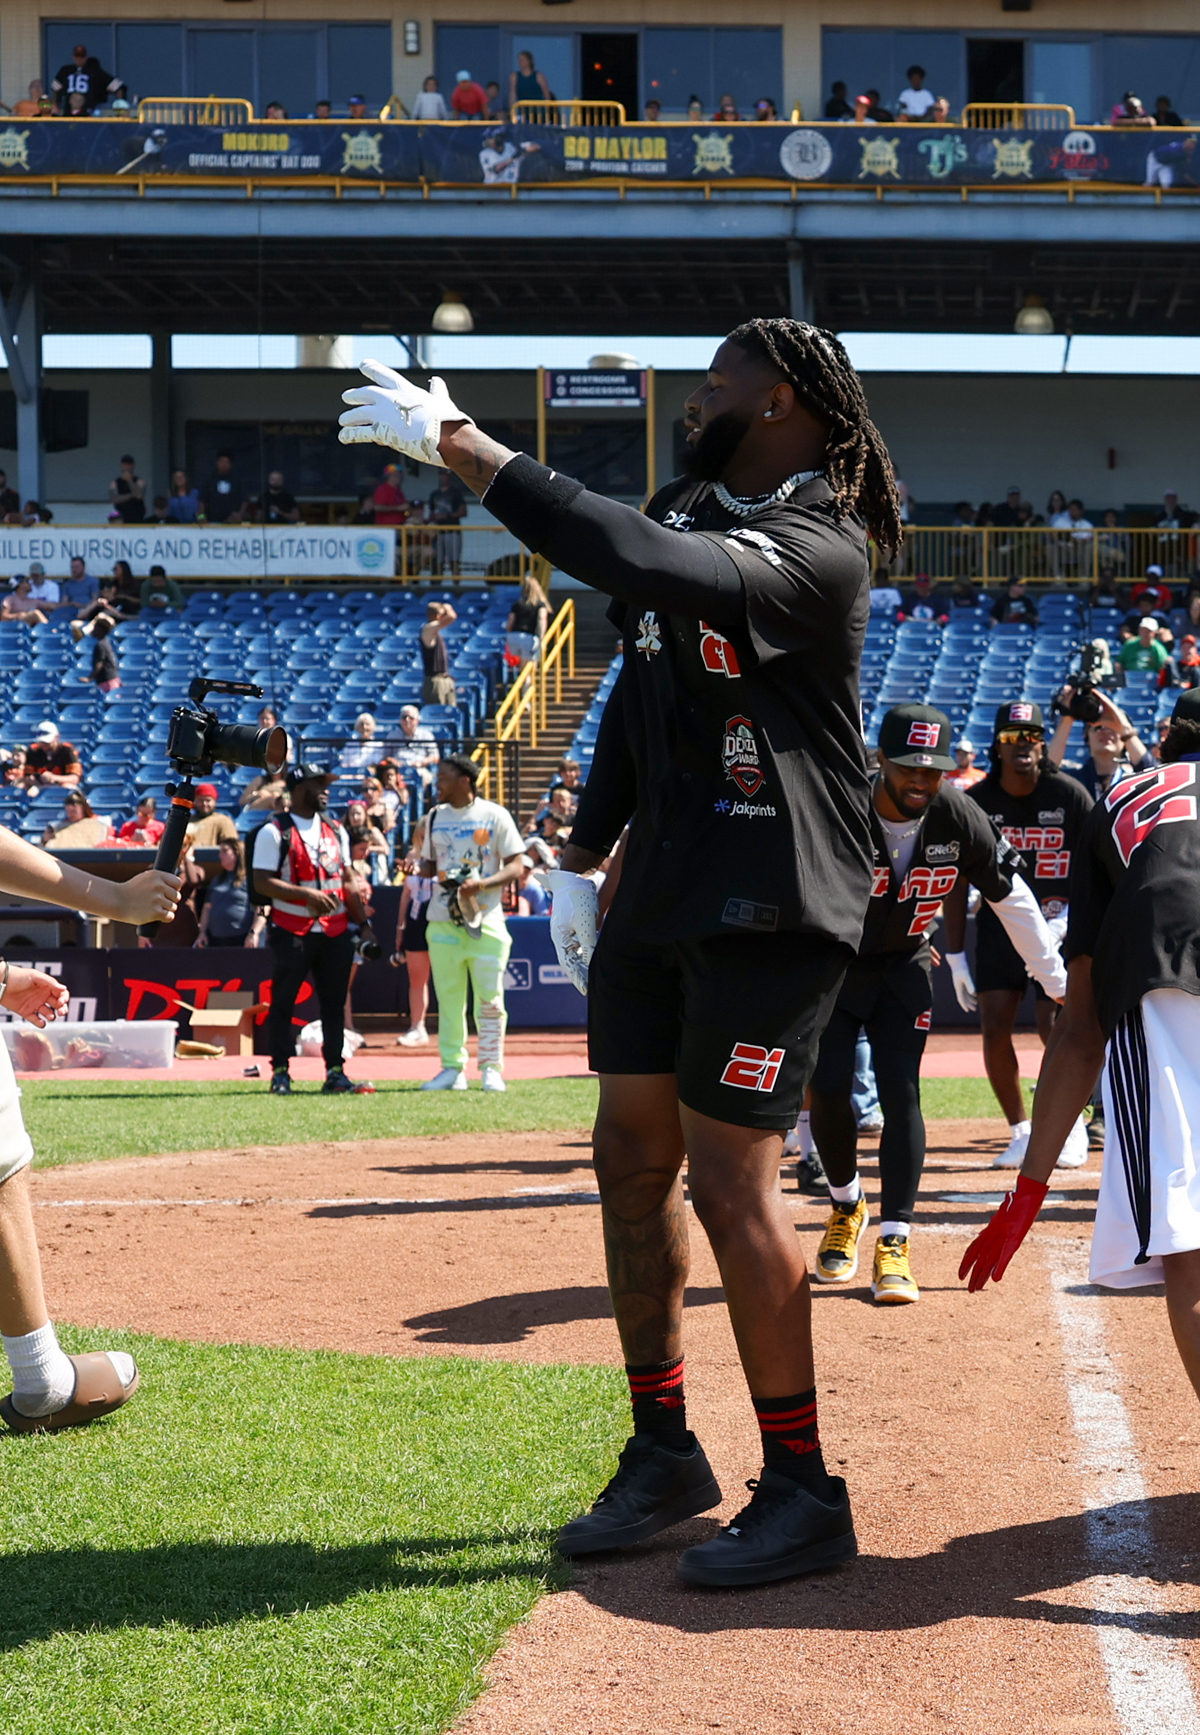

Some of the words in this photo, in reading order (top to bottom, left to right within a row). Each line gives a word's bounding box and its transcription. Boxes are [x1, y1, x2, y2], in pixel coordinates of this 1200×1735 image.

[67, 74, 89, 93] 16
[594, 136, 668, 160] NAYLOR
[189, 154, 227, 167] OFFICIAL
[231, 154, 278, 168] CAPTAINS'
[569, 375, 627, 384] RESTROOMS
[569, 386, 636, 395] CONCESSIONS
[0, 540, 54, 559] ILLED
[61, 540, 147, 559] NURSING
[152, 540, 191, 558] AND
[199, 539, 351, 559] REHABILITATION
[906, 721, 941, 747] 21
[729, 801, 777, 819] jakprints
[1034, 850, 1070, 878] 21
[720, 1042, 786, 1092] 21
